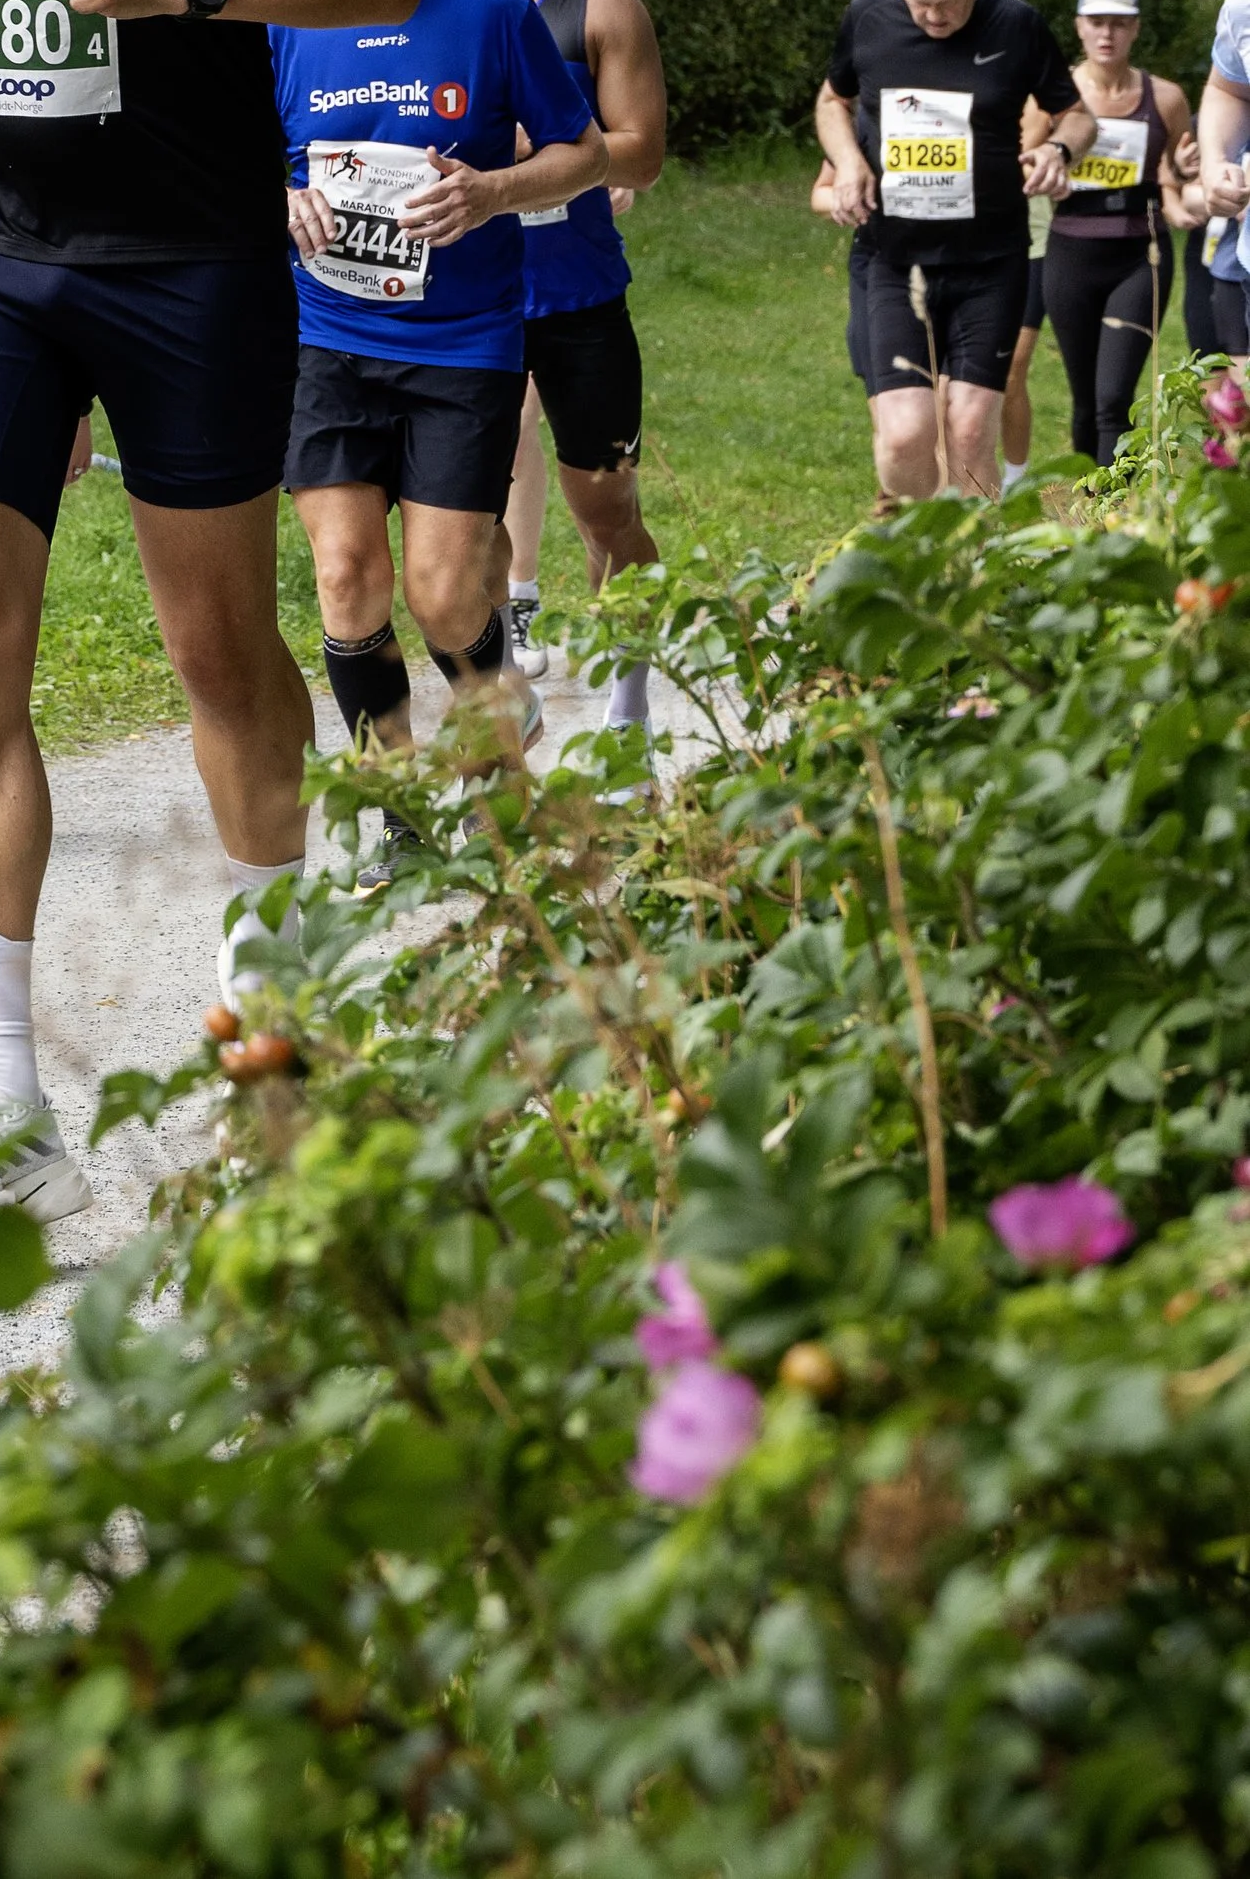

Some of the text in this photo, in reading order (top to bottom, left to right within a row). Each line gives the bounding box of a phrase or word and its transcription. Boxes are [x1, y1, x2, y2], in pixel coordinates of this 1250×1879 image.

[87, 33, 104, 60] 4
[356, 36, 398, 49] CRAFT
[309, 79, 430, 114] SpareBank
[398, 105, 430, 117] SMN
[890, 144, 957, 167] 31285
[369, 166, 426, 182] TRONDHEIM
[368, 177, 416, 190] MARATON
[340, 199, 395, 216] MARATON
[314, 260, 382, 288] SpareBank
[362, 287, 381, 296] SMN
